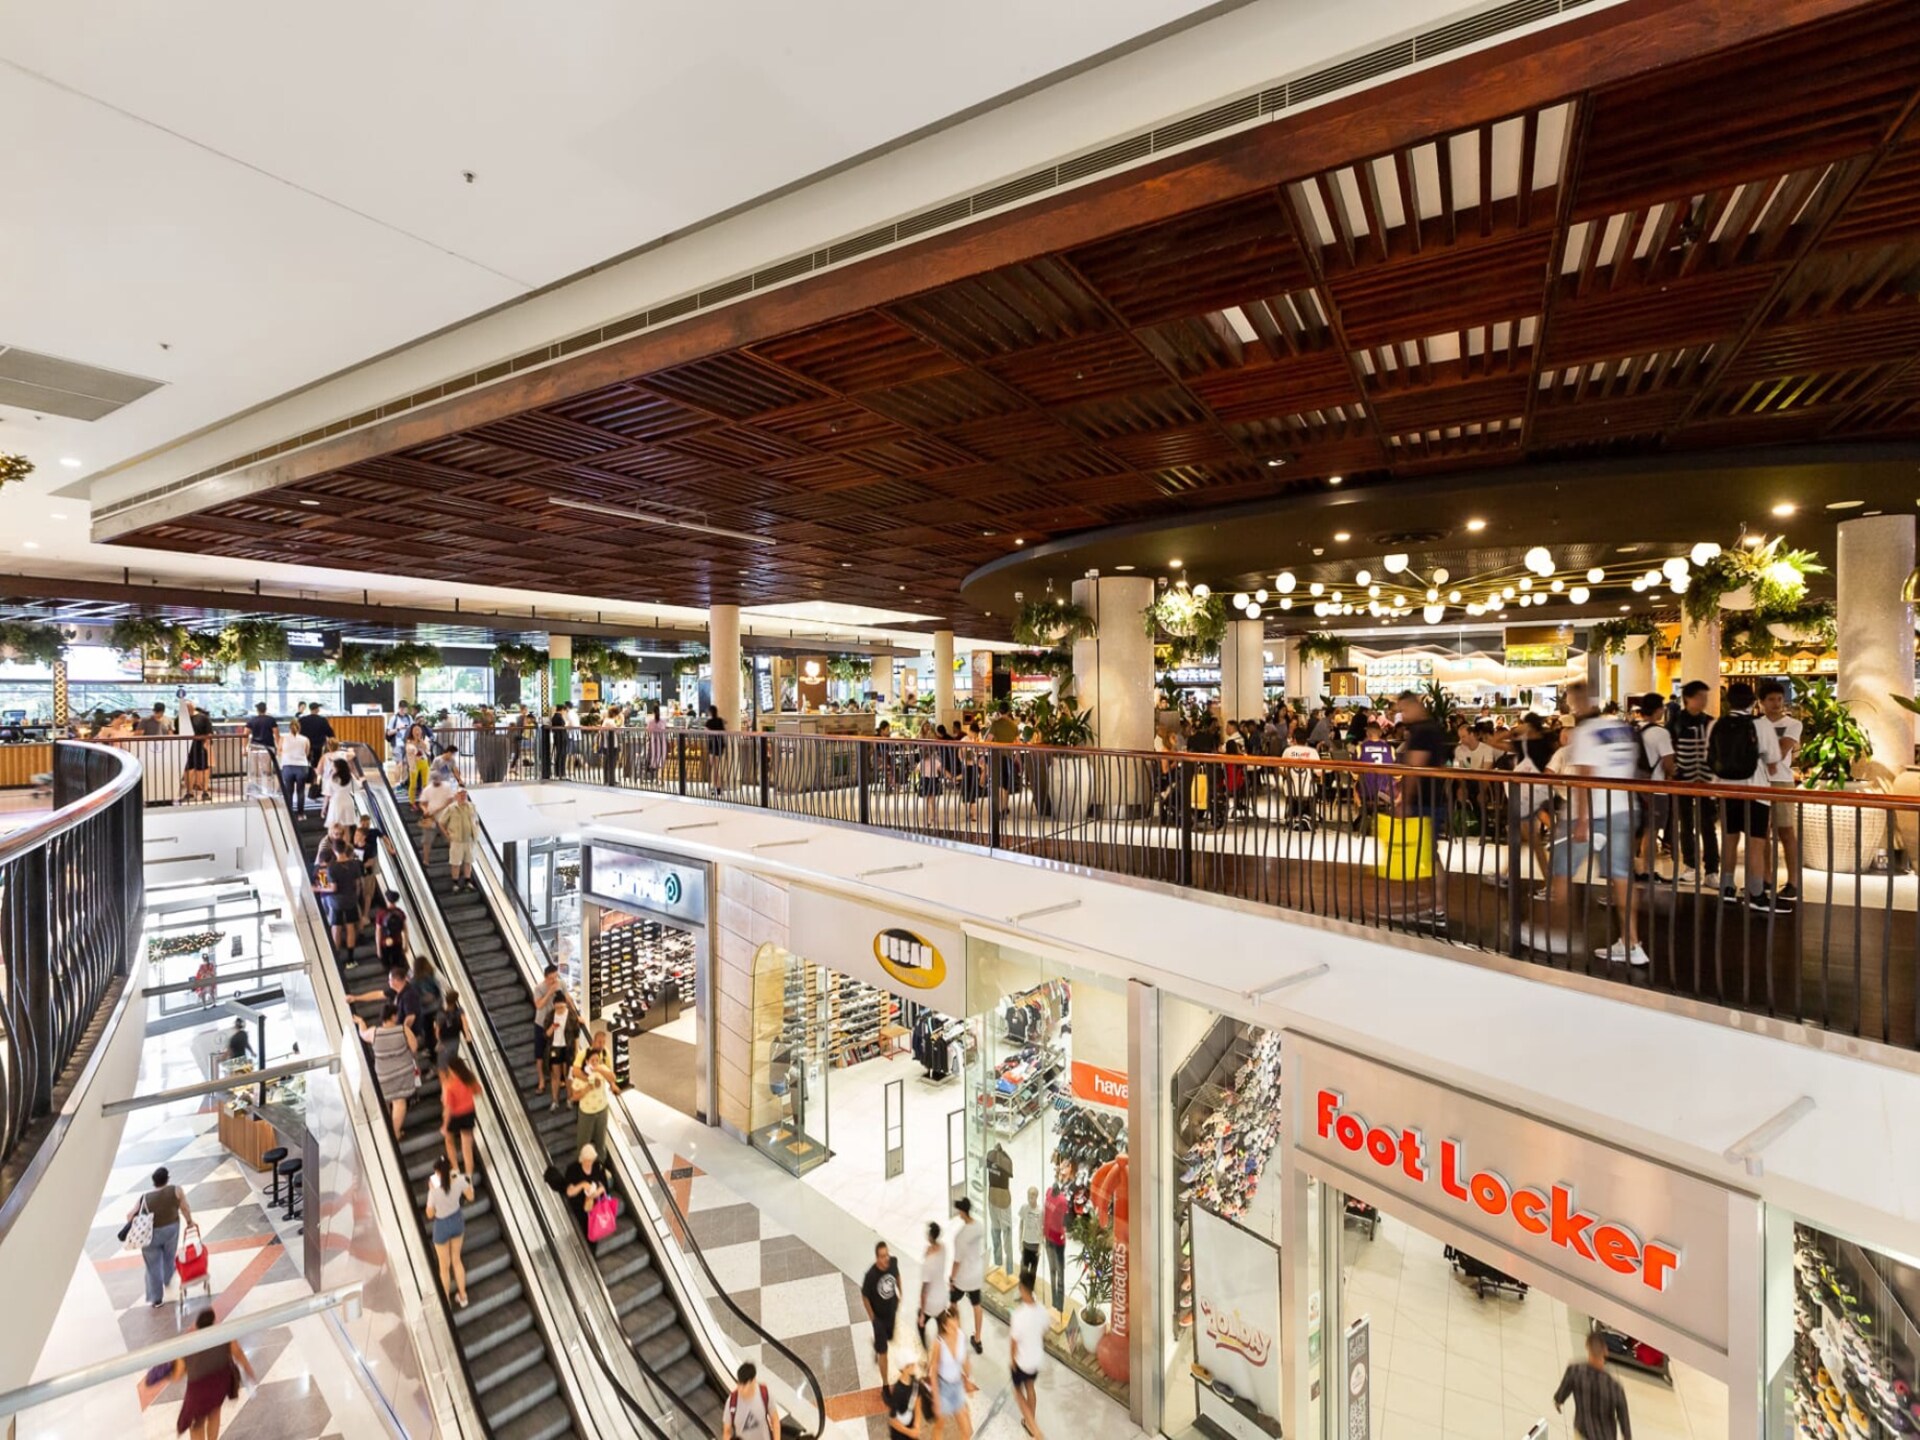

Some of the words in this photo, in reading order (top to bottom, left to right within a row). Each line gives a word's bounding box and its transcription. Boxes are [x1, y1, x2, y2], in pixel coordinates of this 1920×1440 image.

[1094, 1074, 1128, 1099] hava
[1316, 1088, 1429, 1183] Foot
[1440, 1137, 1682, 1293] Locker
[1112, 1242, 1128, 1337] havaianas
